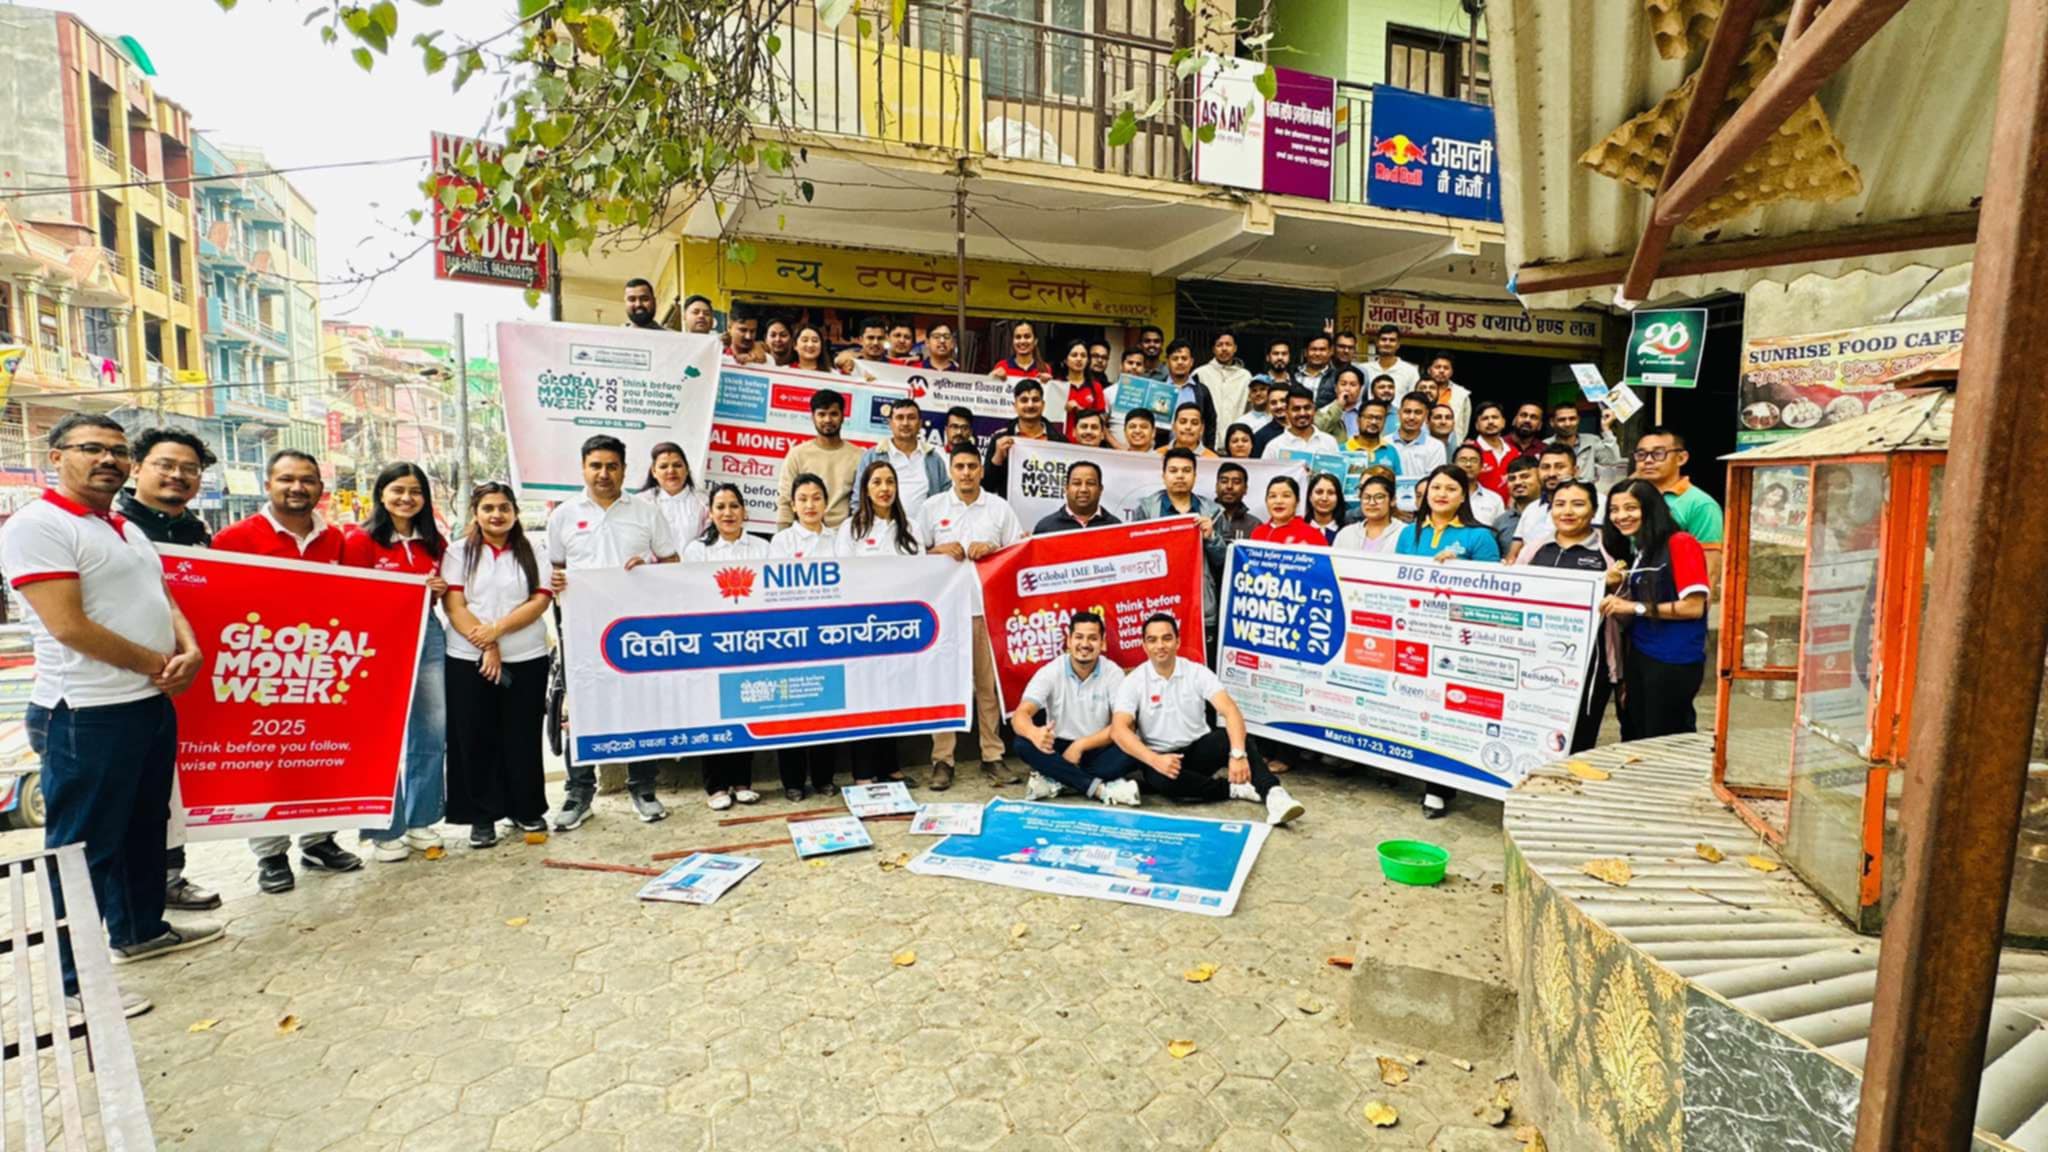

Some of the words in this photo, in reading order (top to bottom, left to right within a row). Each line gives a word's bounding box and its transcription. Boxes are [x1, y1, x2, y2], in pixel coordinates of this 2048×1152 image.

[1430, 137, 1493, 174] असली
[776, 258, 835, 293] न्यू
[1749, 343, 1831, 364] SUNRISE
[1838, 335, 1898, 355] FOOD
[1905, 328, 1964, 349] CAFE
[538, 373, 604, 390] GLOBAL
[649, 379, 682, 392] before
[538, 385, 598, 400] MONEY
[605, 377, 618, 412] 2025
[622, 388, 641, 398] you
[538, 396, 588, 411] WEEK
[646, 399, 680, 411] money
[736, 431, 797, 451] MONEY
[722, 455, 774, 477] वित्तीय
[1022, 458, 1068, 473] GLOB
[1022, 472, 1067, 487] MONE
[1022, 484, 1066, 499] WEE
[763, 561, 841, 590] NIMB
[1038, 570, 1068, 583] Global
[1071, 566, 1090, 578] IME
[1093, 563, 1116, 575] Bank
[1397, 566, 1424, 582] BIG
[1429, 569, 1522, 595] Ramechhap
[1234, 571, 1307, 604] GLOBAL
[1115, 600, 1144, 614] think
[1146, 594, 1182, 608] before
[1232, 595, 1300, 626] MONEY
[1423, 599, 1448, 610] NIMB
[1117, 614, 1138, 627] you
[1306, 588, 1334, 657] 2025
[221, 622, 376, 657] GLOBAL
[620, 629, 702, 660] वित्तीय
[712, 625, 807, 655] साक्षरता
[819, 613, 922, 646] कार्यक्रम
[1231, 617, 1291, 650] WEEK
[214, 650, 362, 679] MONEY
[1521, 670, 1559, 683] Reliable
[211, 676, 337, 705] WEEK
[250, 719, 306, 737] 2025
[179, 741, 221, 754] Think
[226, 740, 277, 754] before
[280, 742, 306, 755] you
[1324, 728, 1354, 743] March
[1357, 737, 1387, 754] 17-23,
[1388, 745, 1414, 760] 2025
[181, 760, 217, 772] wise
[220, 758, 273, 772] money
[278, 756, 345, 769] tomorrow
